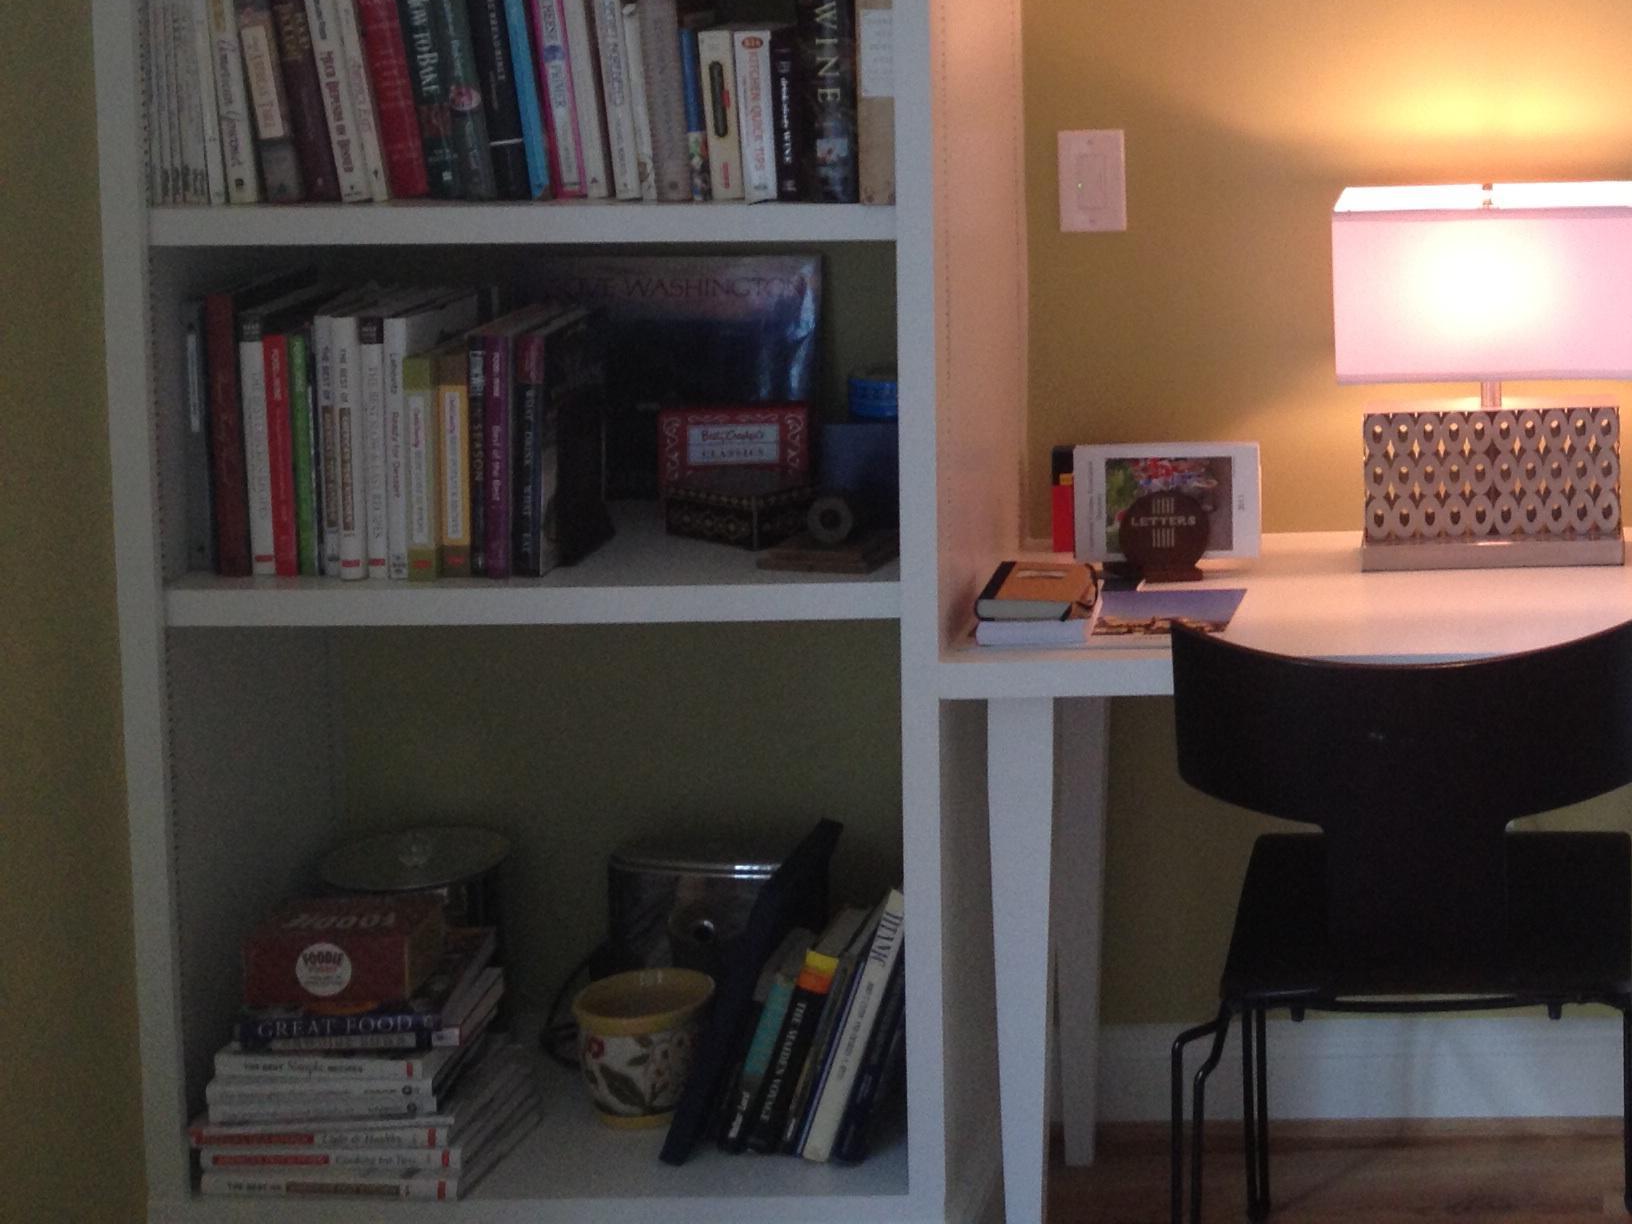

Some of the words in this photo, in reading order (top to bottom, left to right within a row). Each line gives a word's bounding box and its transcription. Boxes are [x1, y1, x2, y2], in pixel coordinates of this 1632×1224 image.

[413, 32, 432, 51] TO
[814, 0, 841, 104] WINE
[415, 51, 442, 97] BAKE
[549, 64, 567, 108] PRIMER
[748, 50, 763, 101] KITCHEN
[751, 105, 765, 143] QUICK
[754, 147, 765, 172] TIPS
[625, 276, 806, 299] WASHINGTON
[339, 348, 348, 363] THE
[339, 367, 348, 390] BEST
[389, 411, 401, 442] Ready
[491, 425, 501, 447] Best
[701, 430, 725, 446] Betty
[472, 423, 484, 482] SEASON
[391, 461, 402, 498] Dessert
[492, 461, 500, 477] the
[492, 479, 502, 502] Best
[1130, 516, 1197, 527] LETTERS
[869, 911, 904, 968] TITANIC
[302, 952, 343, 967] FOODIE
[257, 1019, 335, 1038] GREAT
[345, 1014, 415, 1034] FOOD
[791, 1002, 808, 1028] THE
[779, 1030, 798, 1073] MAIDEN
[243, 1063, 262, 1072] THE
[265, 1063, 285, 1072] BEST
[760, 1076, 781, 1121] VOYAGE
